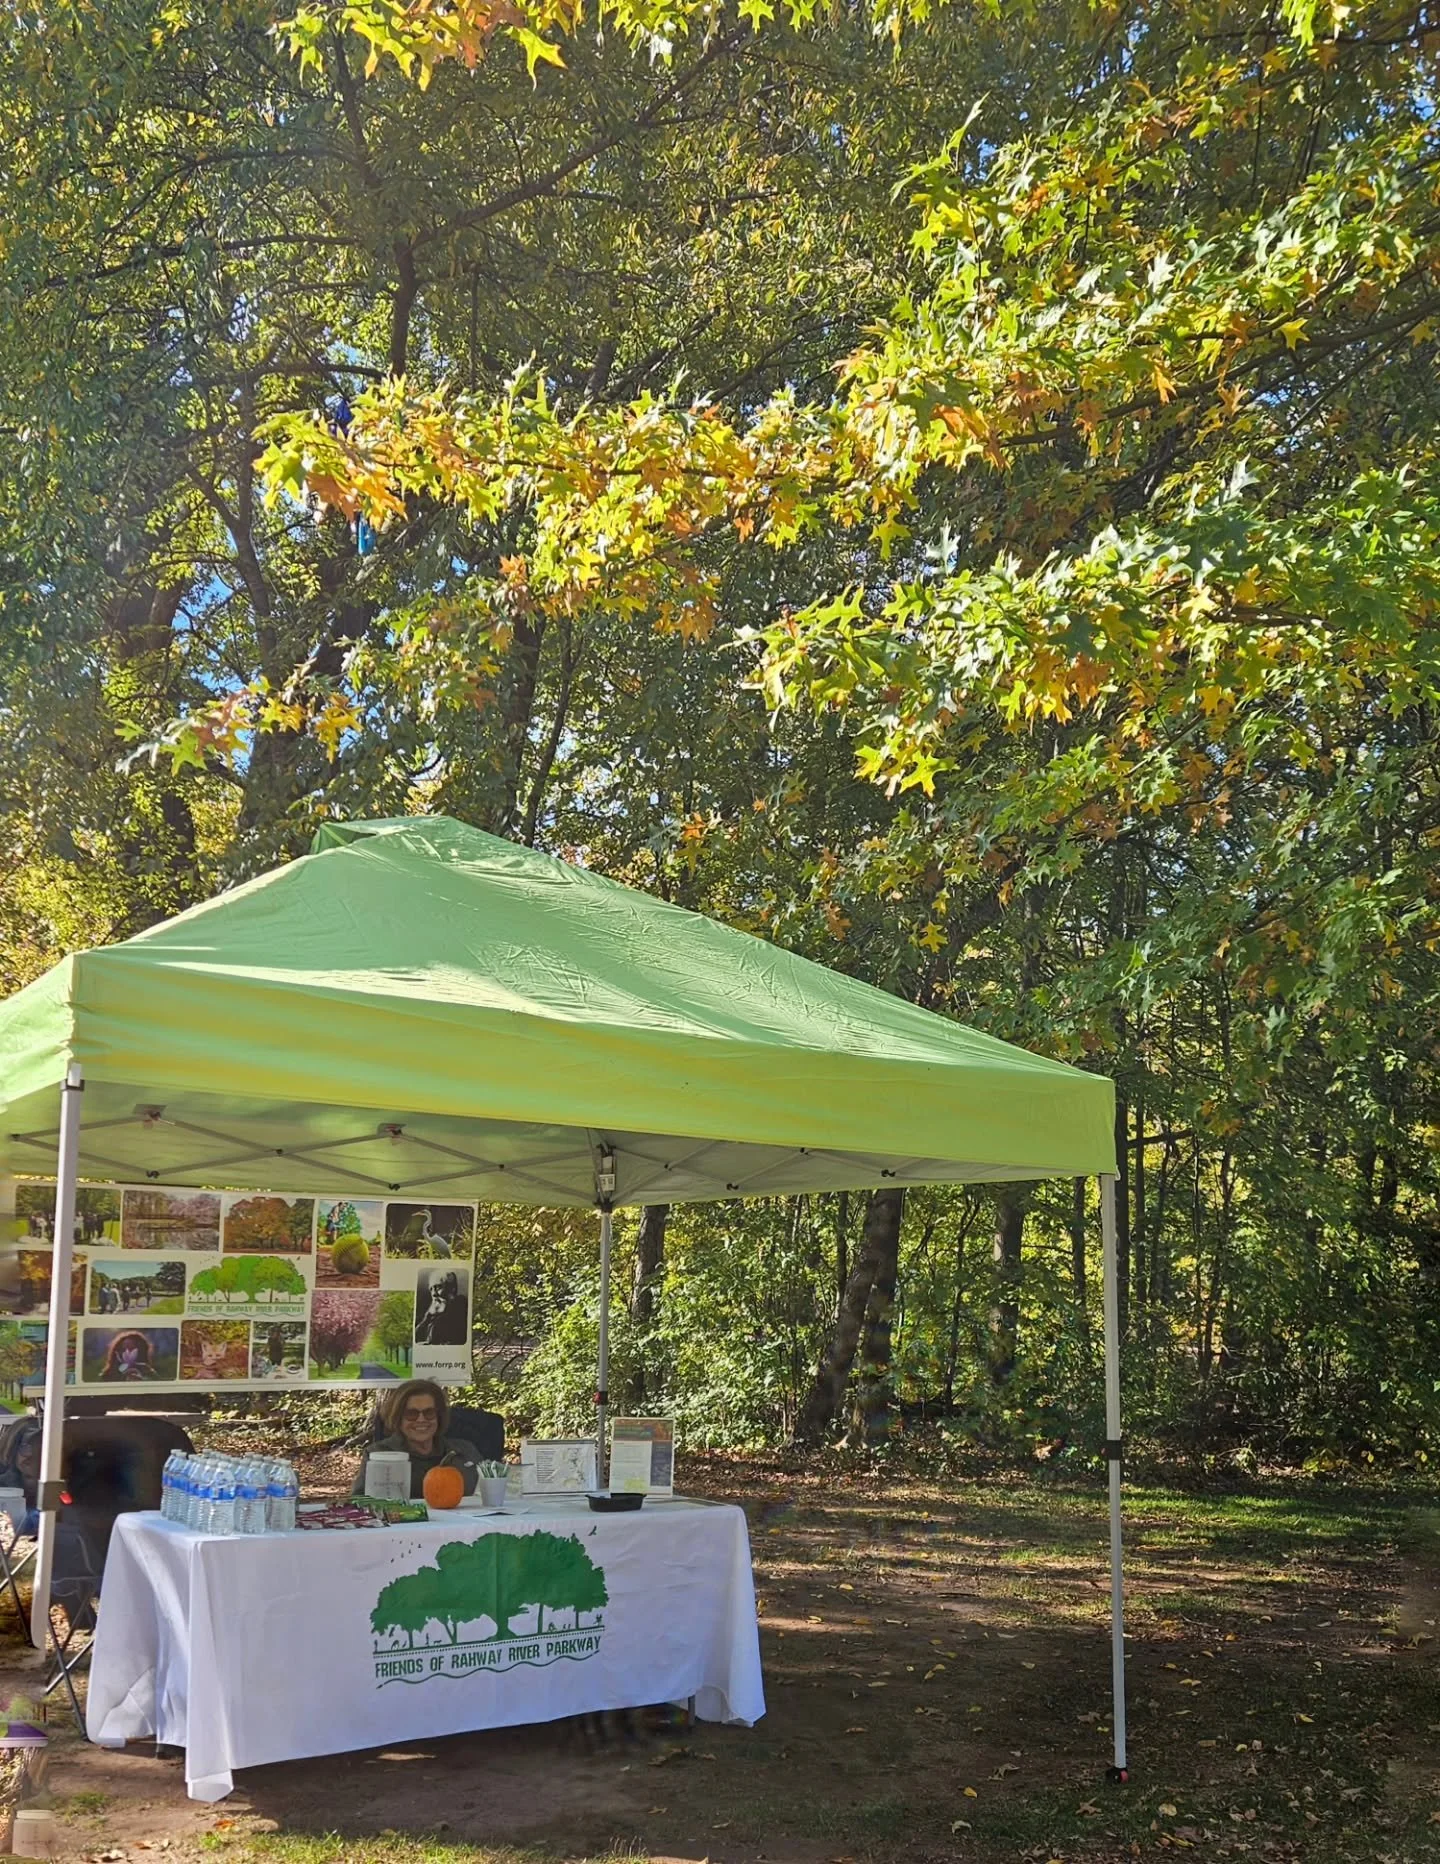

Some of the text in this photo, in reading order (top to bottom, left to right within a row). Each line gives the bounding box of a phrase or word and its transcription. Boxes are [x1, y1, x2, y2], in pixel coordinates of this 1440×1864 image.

[415, 1361, 466, 1370] www.forrp.org
[375, 1636, 601, 1678] FRIENDS OF RAHWAY RIVER PARKWAY
